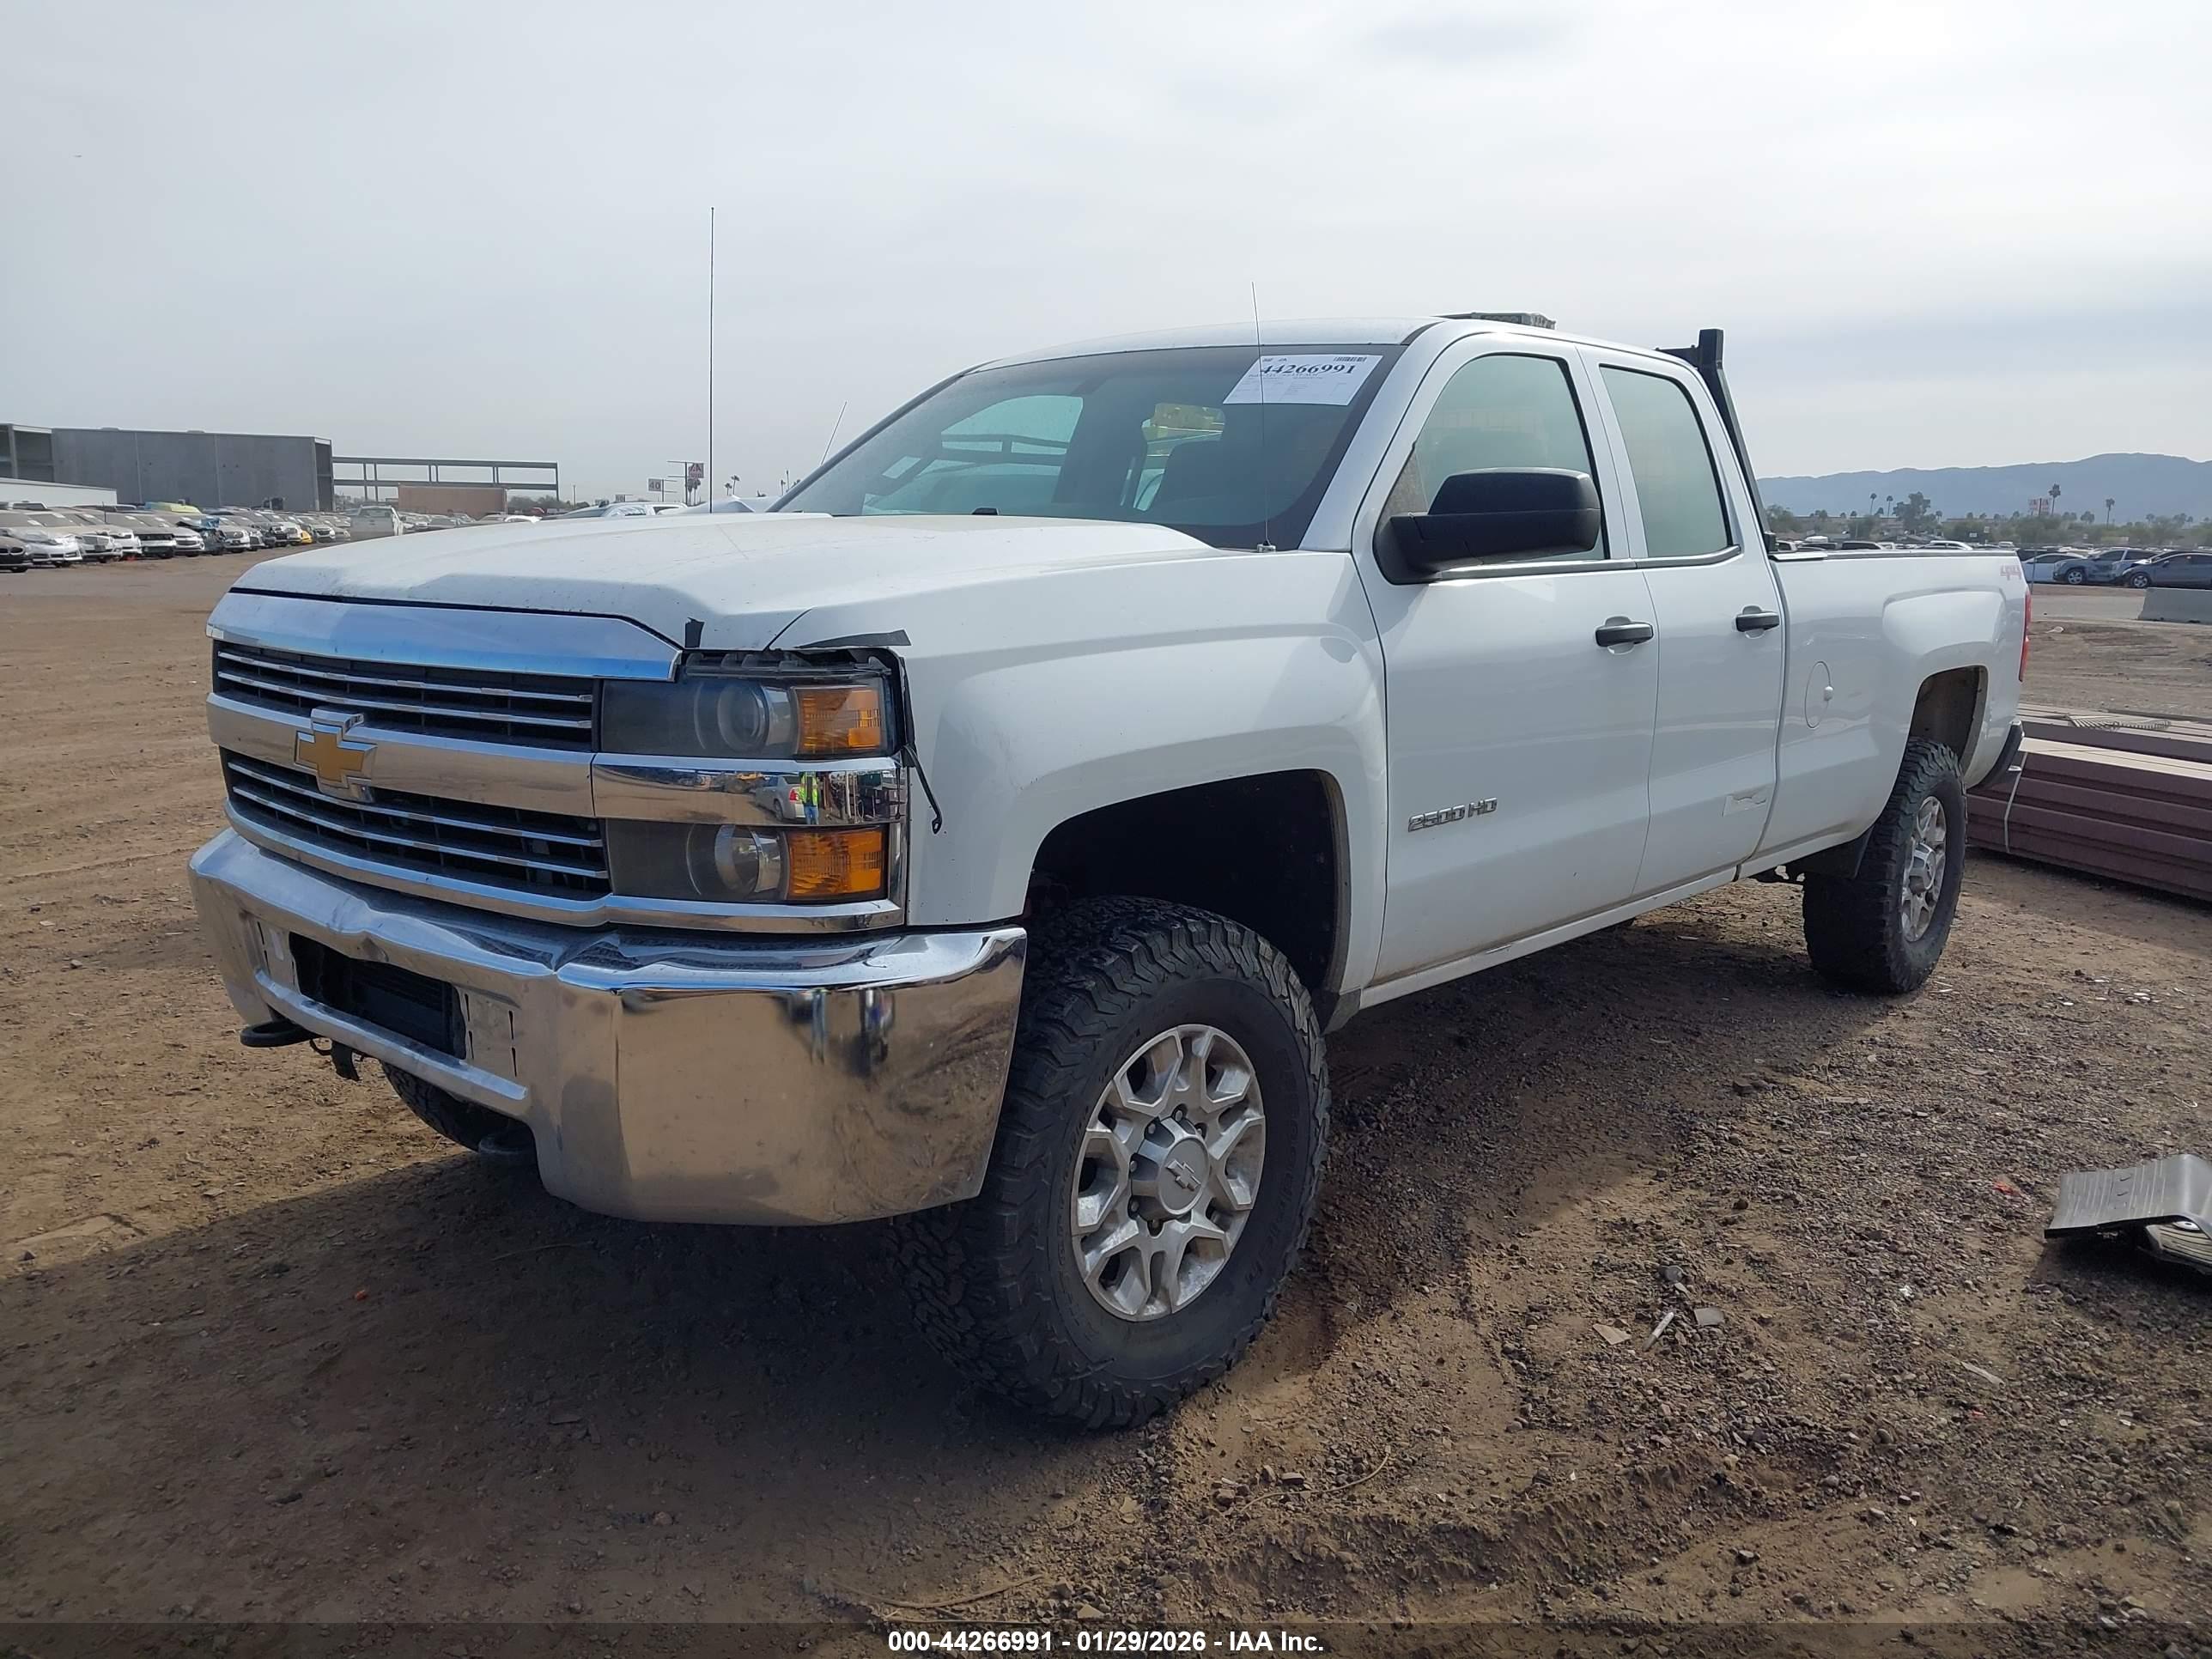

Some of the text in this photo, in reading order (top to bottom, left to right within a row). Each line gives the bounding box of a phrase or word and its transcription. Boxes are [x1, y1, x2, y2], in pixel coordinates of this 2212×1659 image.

[1261, 364, 1356, 374] 44266991
[1408, 797, 1498, 832] 2500 HD
